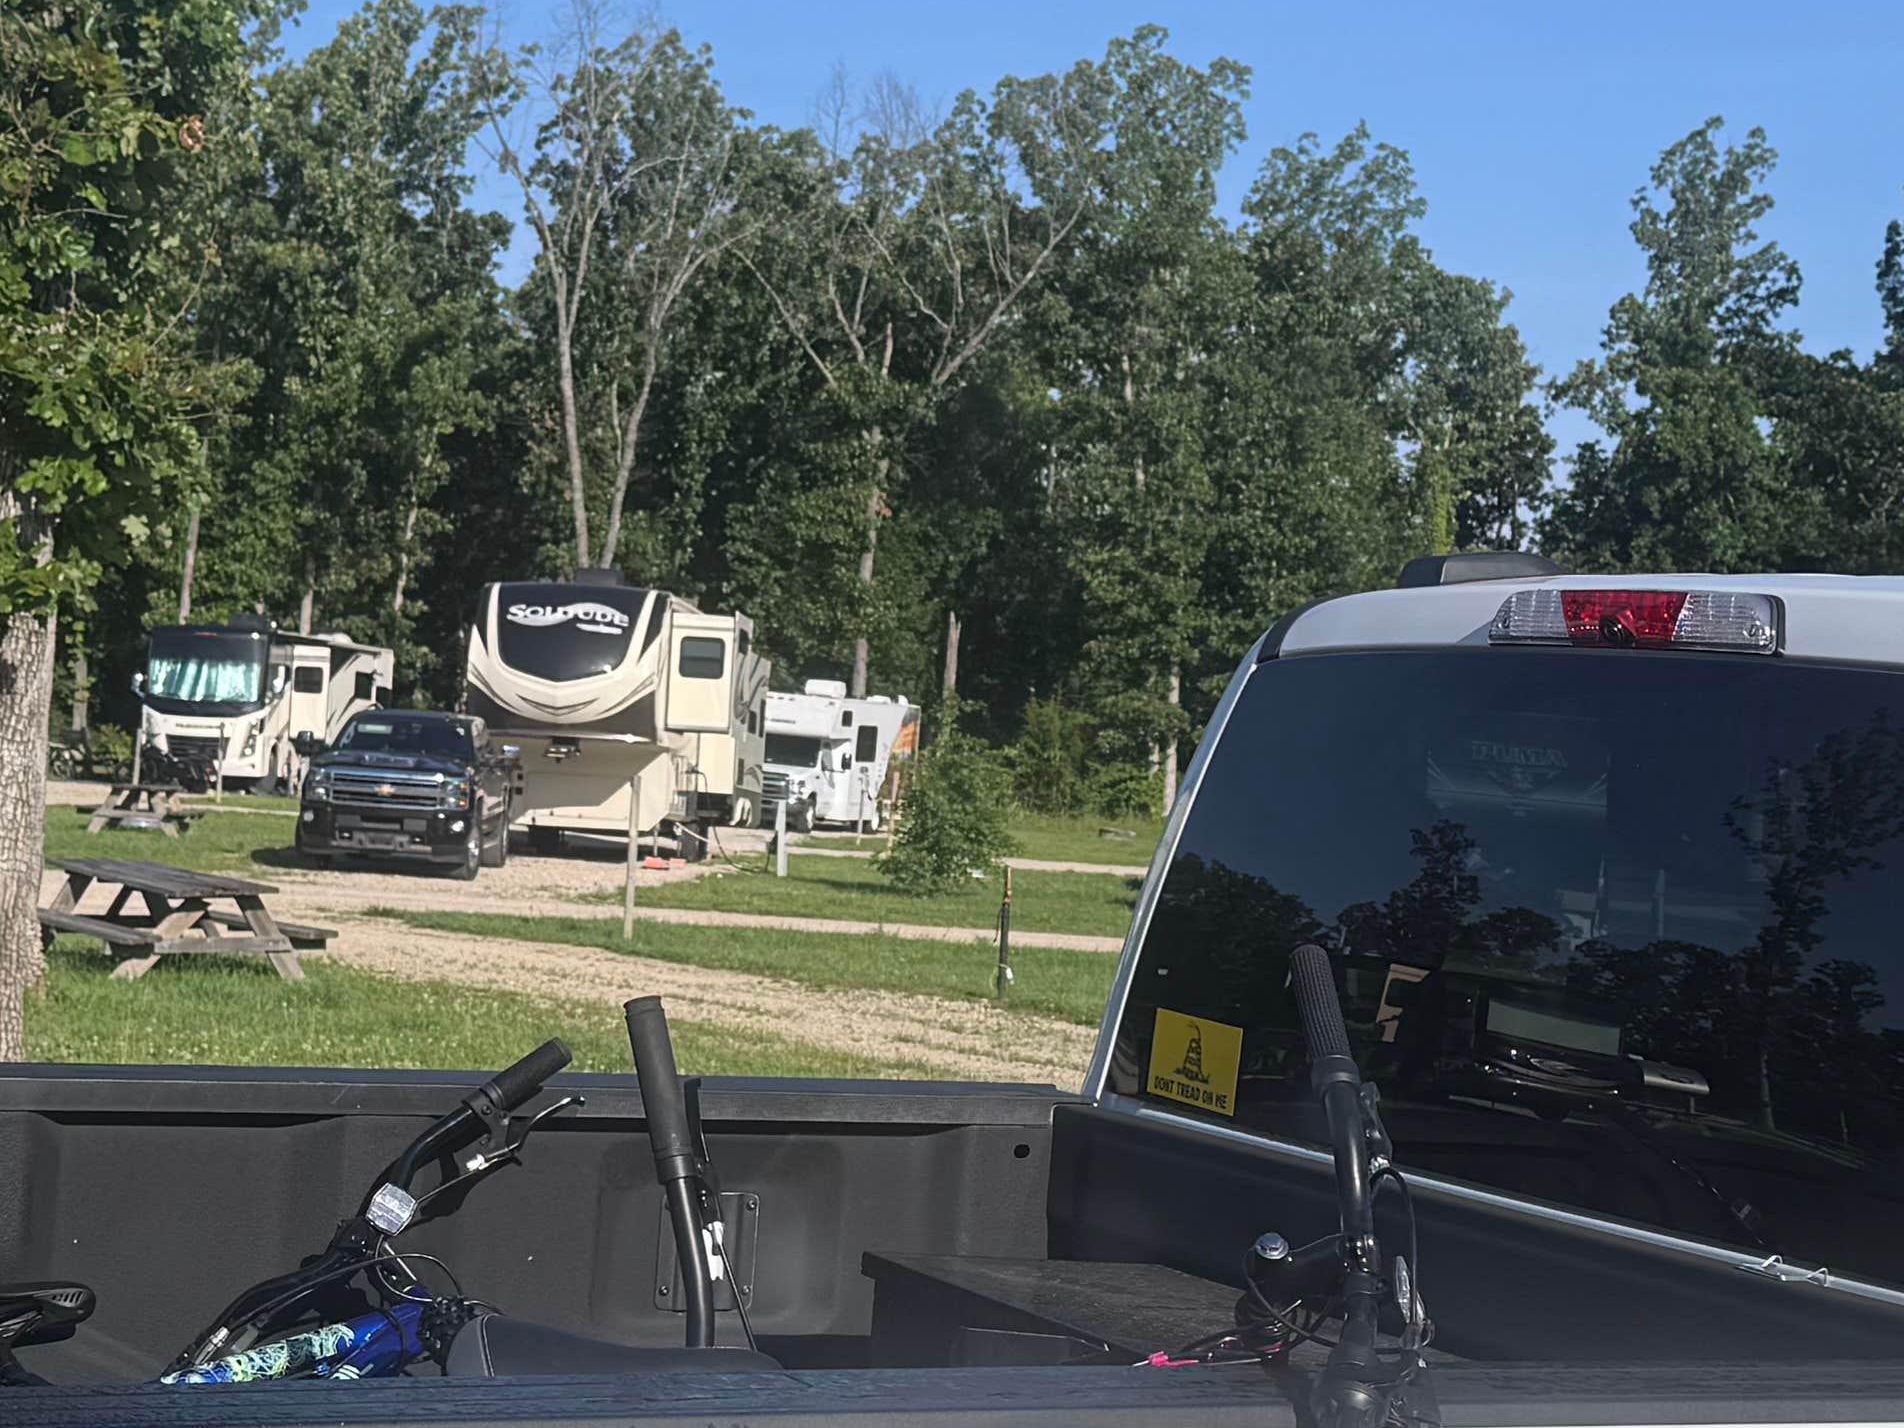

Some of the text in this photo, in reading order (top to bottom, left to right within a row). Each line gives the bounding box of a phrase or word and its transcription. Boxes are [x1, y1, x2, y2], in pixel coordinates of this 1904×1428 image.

[1176, 1081, 1201, 1101] TREAD
[1202, 1089, 1214, 1106] ON
[1215, 1092, 1229, 1109] ME
